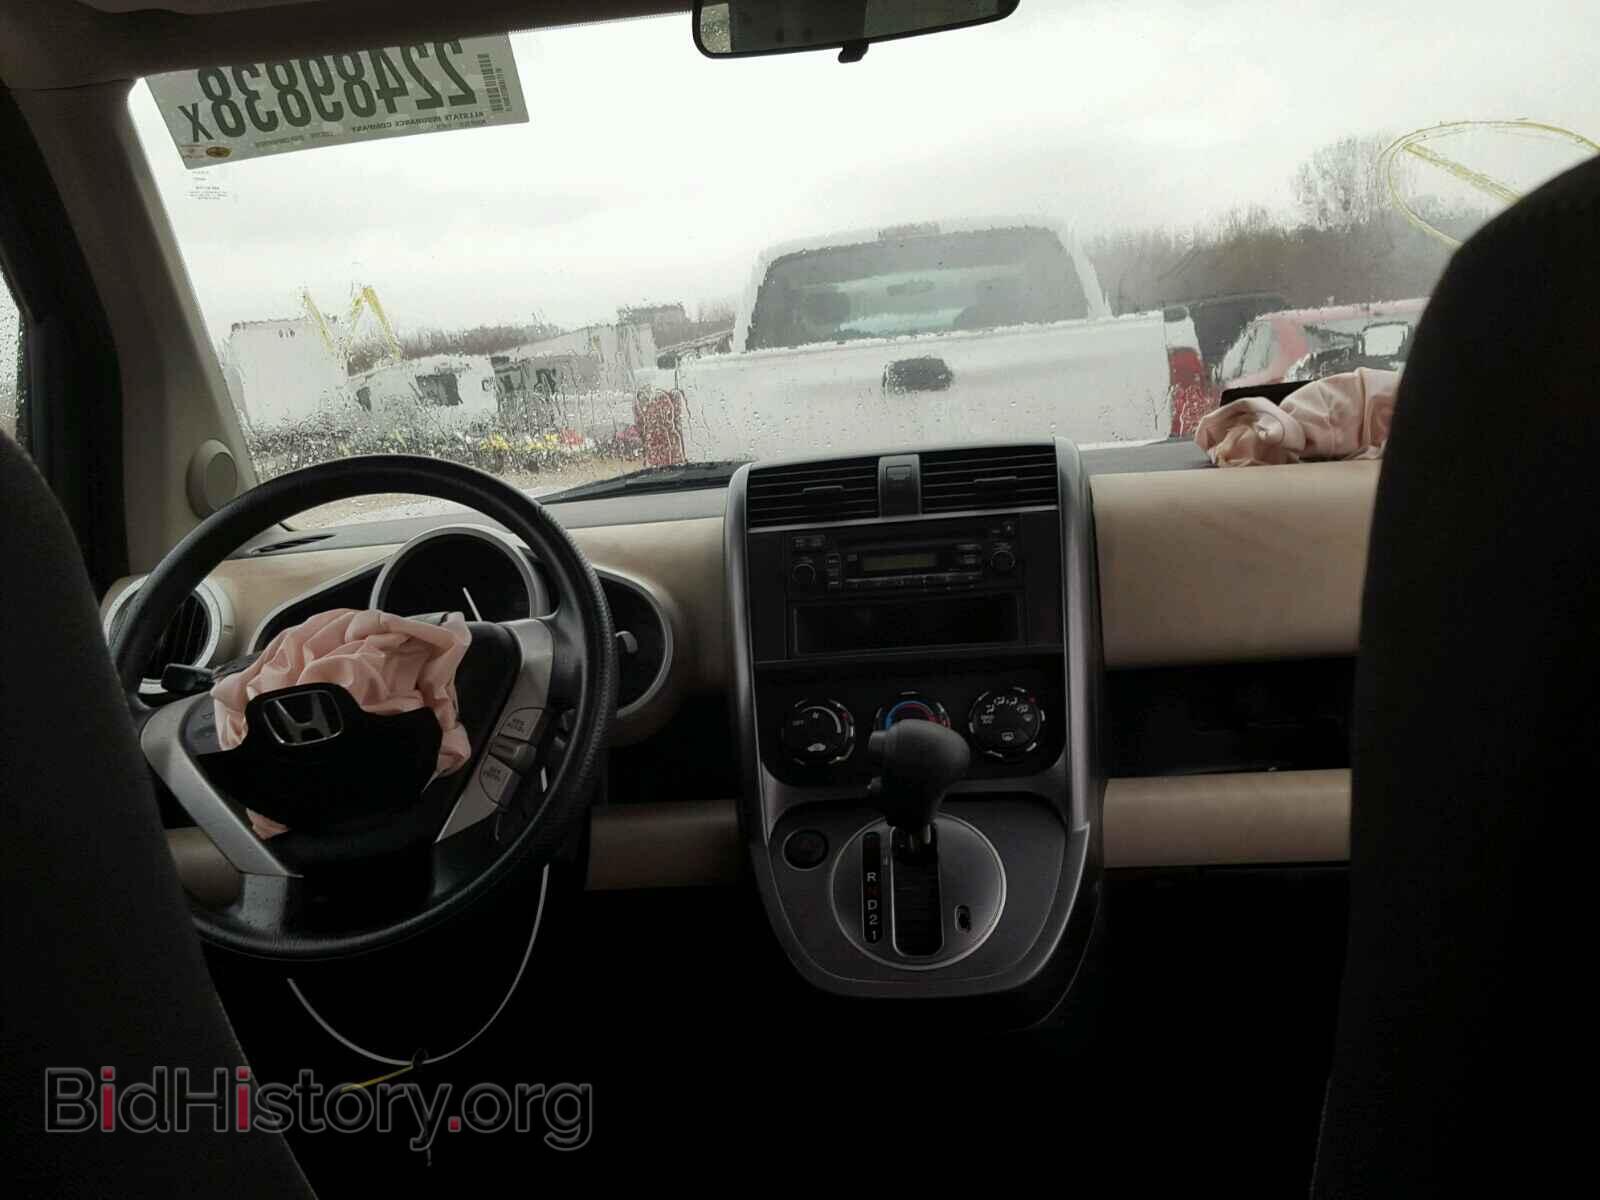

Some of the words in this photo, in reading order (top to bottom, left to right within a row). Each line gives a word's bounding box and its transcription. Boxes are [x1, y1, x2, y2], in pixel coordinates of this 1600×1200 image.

[866, 872, 877, 882] R
[867, 899, 878, 910] D
[868, 914, 879, 925] 2
